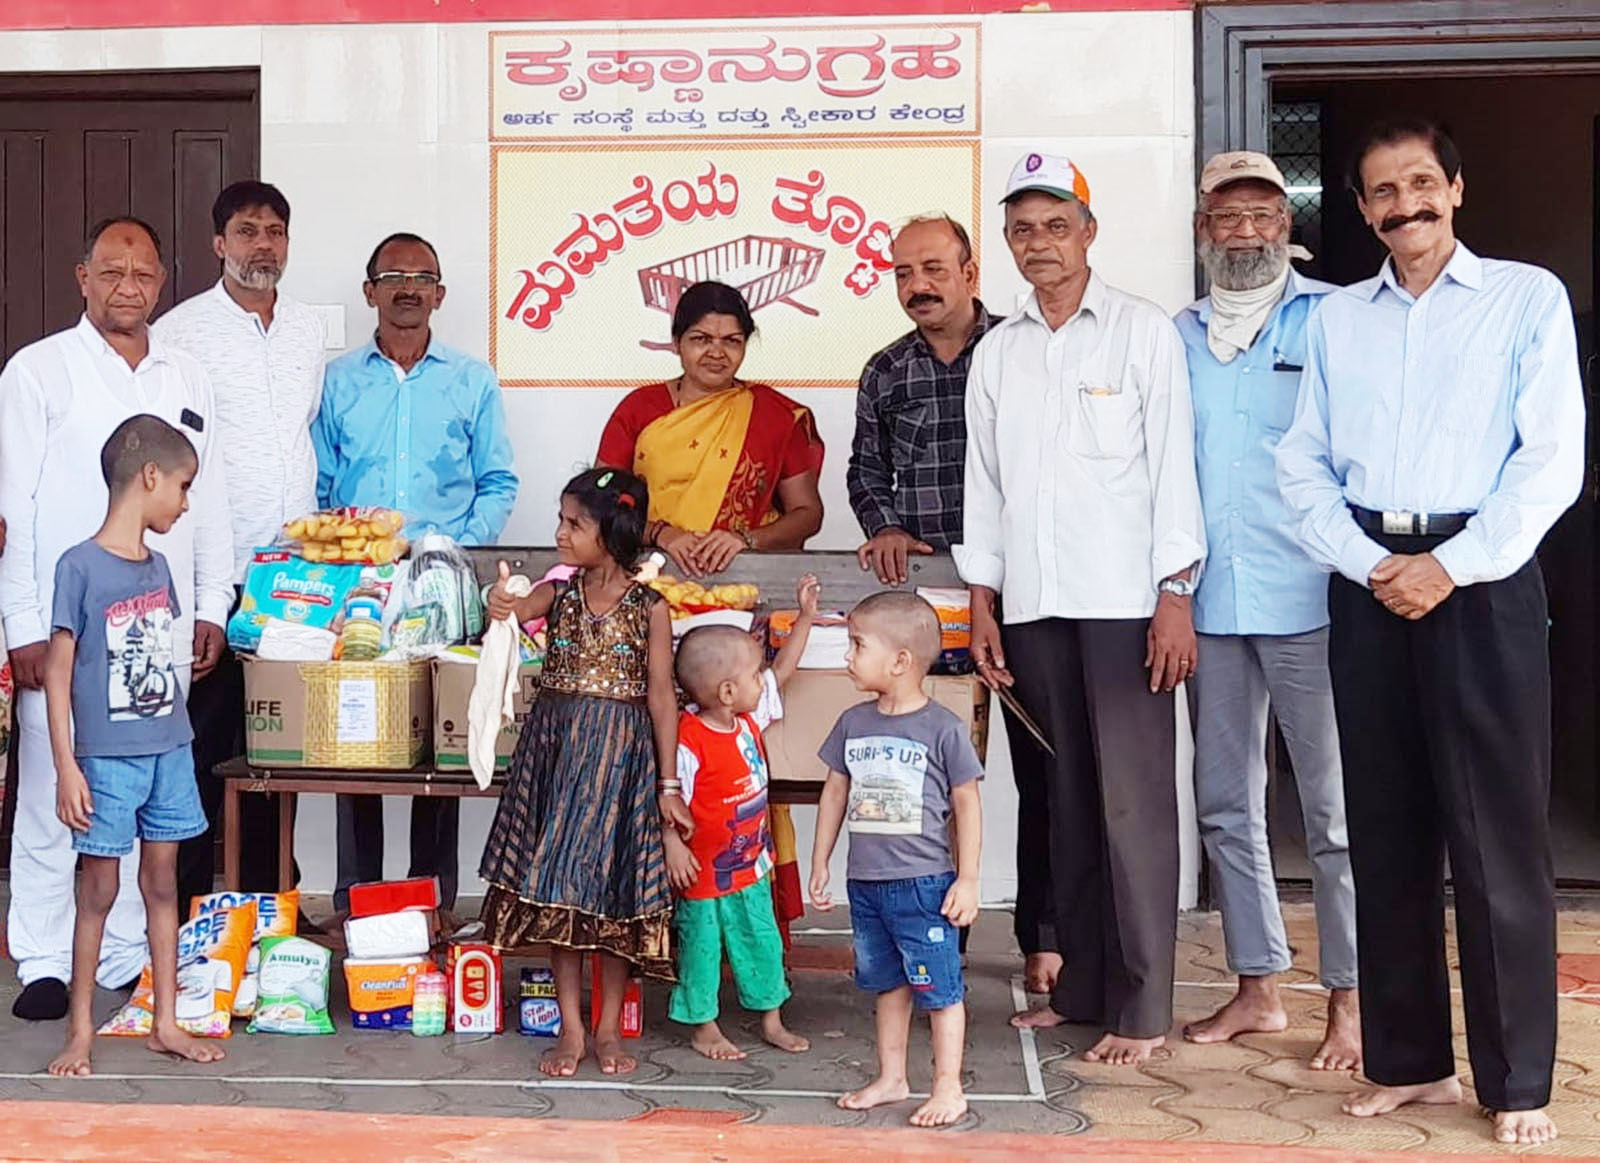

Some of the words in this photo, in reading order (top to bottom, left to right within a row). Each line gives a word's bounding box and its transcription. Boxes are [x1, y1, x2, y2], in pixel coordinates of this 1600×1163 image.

[506, 31, 961, 101] ಕೃಷ್ಣಾನುಗ್ರಹ
[573, 108, 634, 132] ಸಂಸ್ಥೆ
[646, 109, 707, 129] ಮತ್ತು
[718, 107, 770, 128] ದತ್ತು
[781, 106, 876, 128] ಸ್ವೀಕಾರ
[889, 104, 965, 124] ಕೇಂದ್ರ
[505, 160, 739, 329] ಮಮತೆಯ
[272, 571, 336, 595] Pampers
[246, 700, 282, 716] IFE
[899, 748, 922, 765] UP
[180, 911, 229, 940] ORE
